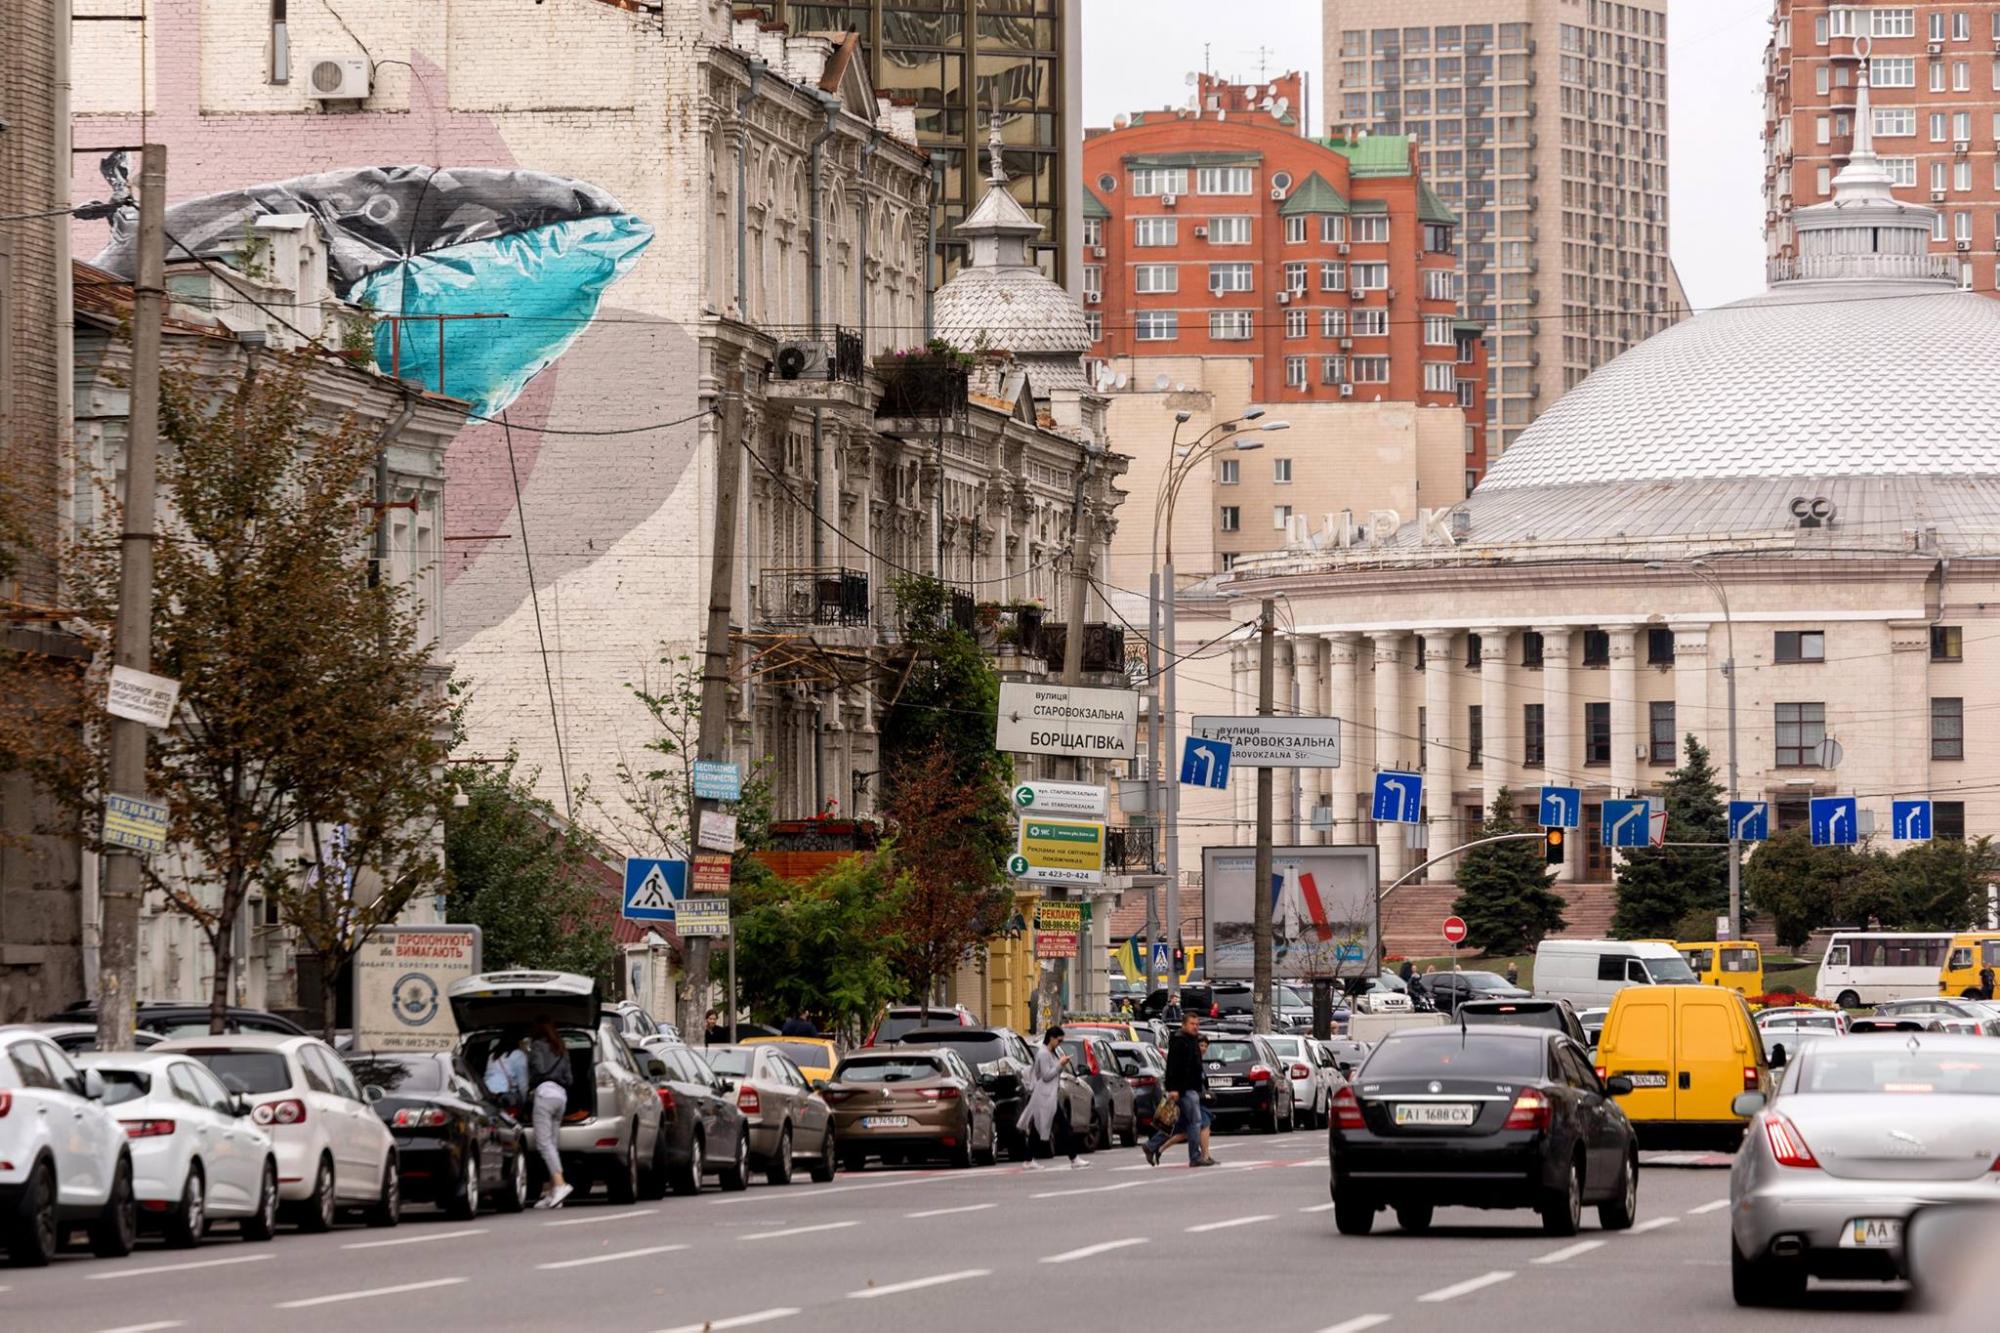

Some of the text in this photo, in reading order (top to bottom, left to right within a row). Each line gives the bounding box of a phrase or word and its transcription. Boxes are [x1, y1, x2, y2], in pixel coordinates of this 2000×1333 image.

[1035, 692, 1068, 701] вулиця
[1033, 705, 1125, 720] СТАРОВОКЗАЛЬНА
[1219, 727, 1260, 735] вулиця
[1030, 732, 1125, 750] БОРЩАГІВКА
[1295, 751, 1310, 759] Str.
[1048, 870, 1089, 879] 423-0-424
[1041, 909, 1080, 920] РЕКЛАМУ?
[398, 934, 473, 946] ПРОПОНУЮТЬ
[396, 946, 463, 958] ВИМАГАЮТЬ
[1451, 1109, 1468, 1120] CX
[1866, 1222, 1888, 1238] AA
